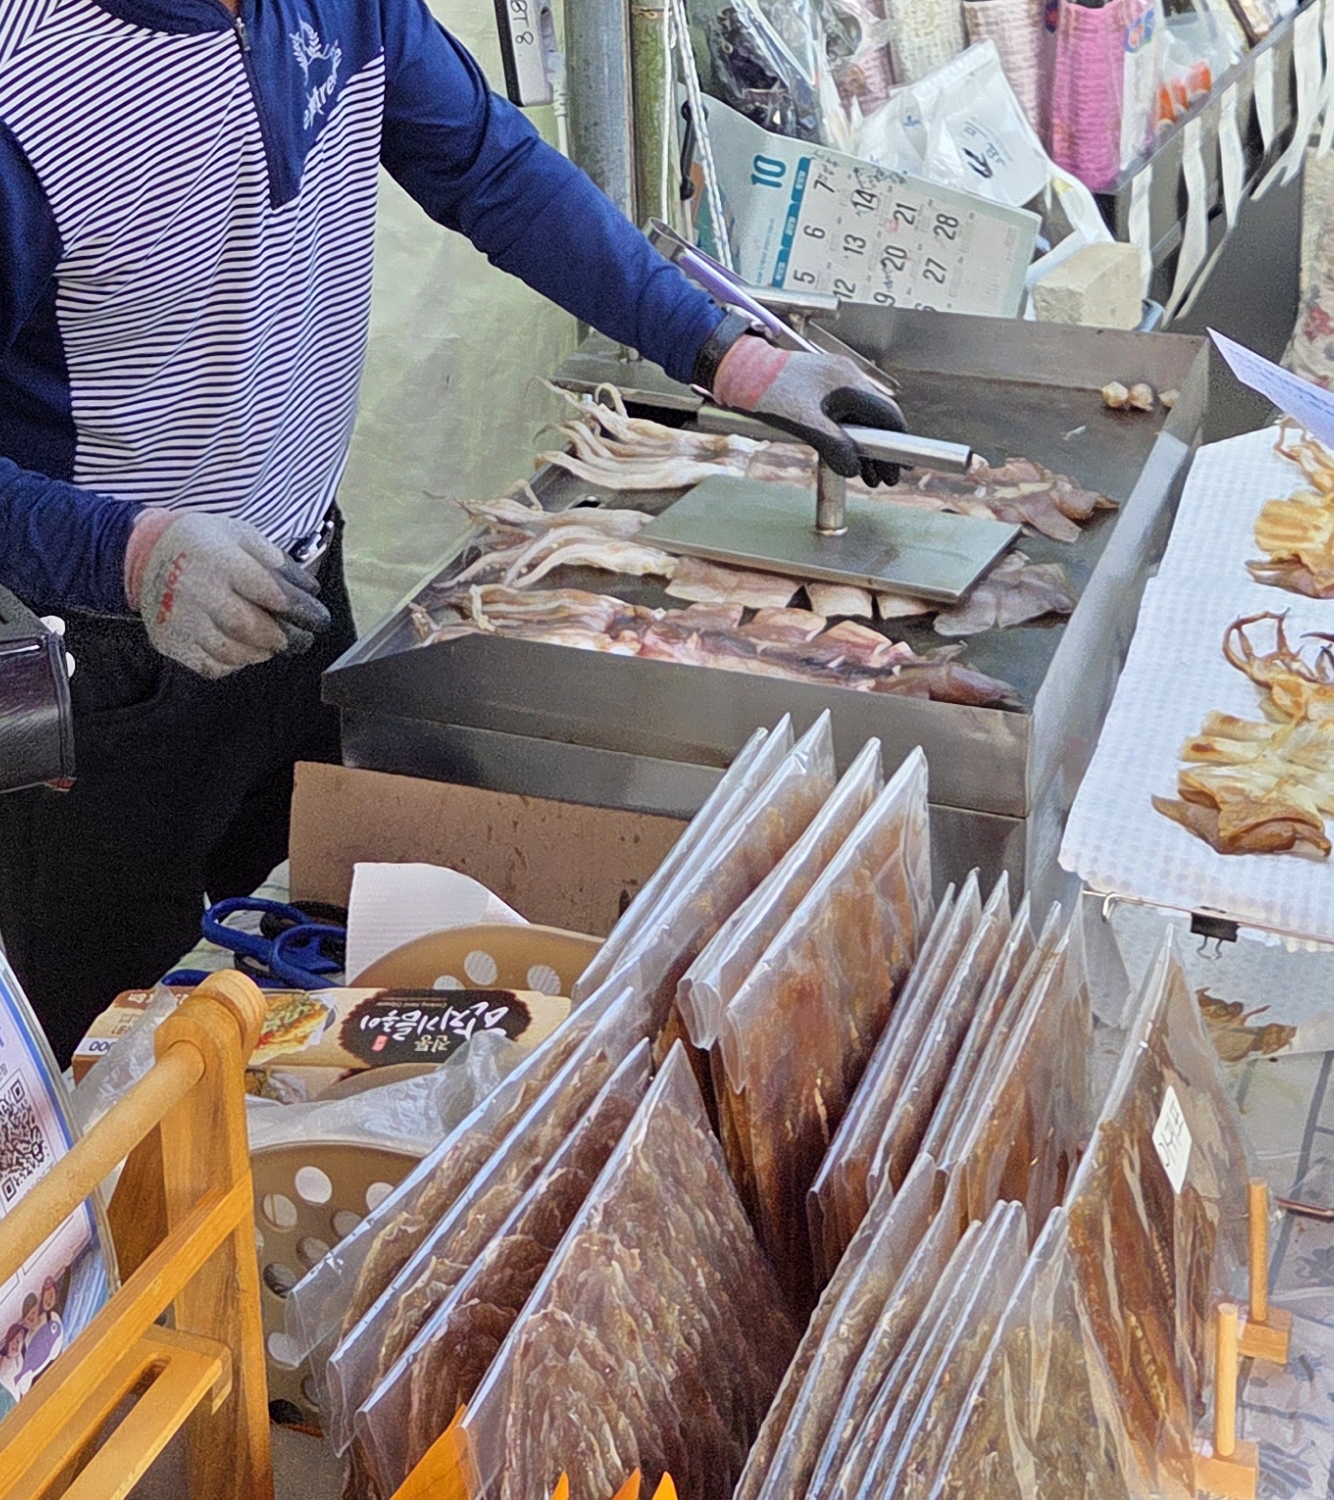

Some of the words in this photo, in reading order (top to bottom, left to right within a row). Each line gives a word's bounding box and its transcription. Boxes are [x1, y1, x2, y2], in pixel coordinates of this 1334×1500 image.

[751, 154, 786, 188] 10
[813, 179, 835, 193] 7
[852, 189, 878, 211] 14
[893, 203, 918, 225] 21
[803, 225, 826, 239] 6
[933, 213, 959, 240] 28
[844, 234, 867, 256] 13
[880, 245, 907, 272] 20
[793, 268, 816, 285] 5
[922, 258, 948, 284] 27
[833, 278, 856, 300] 12
